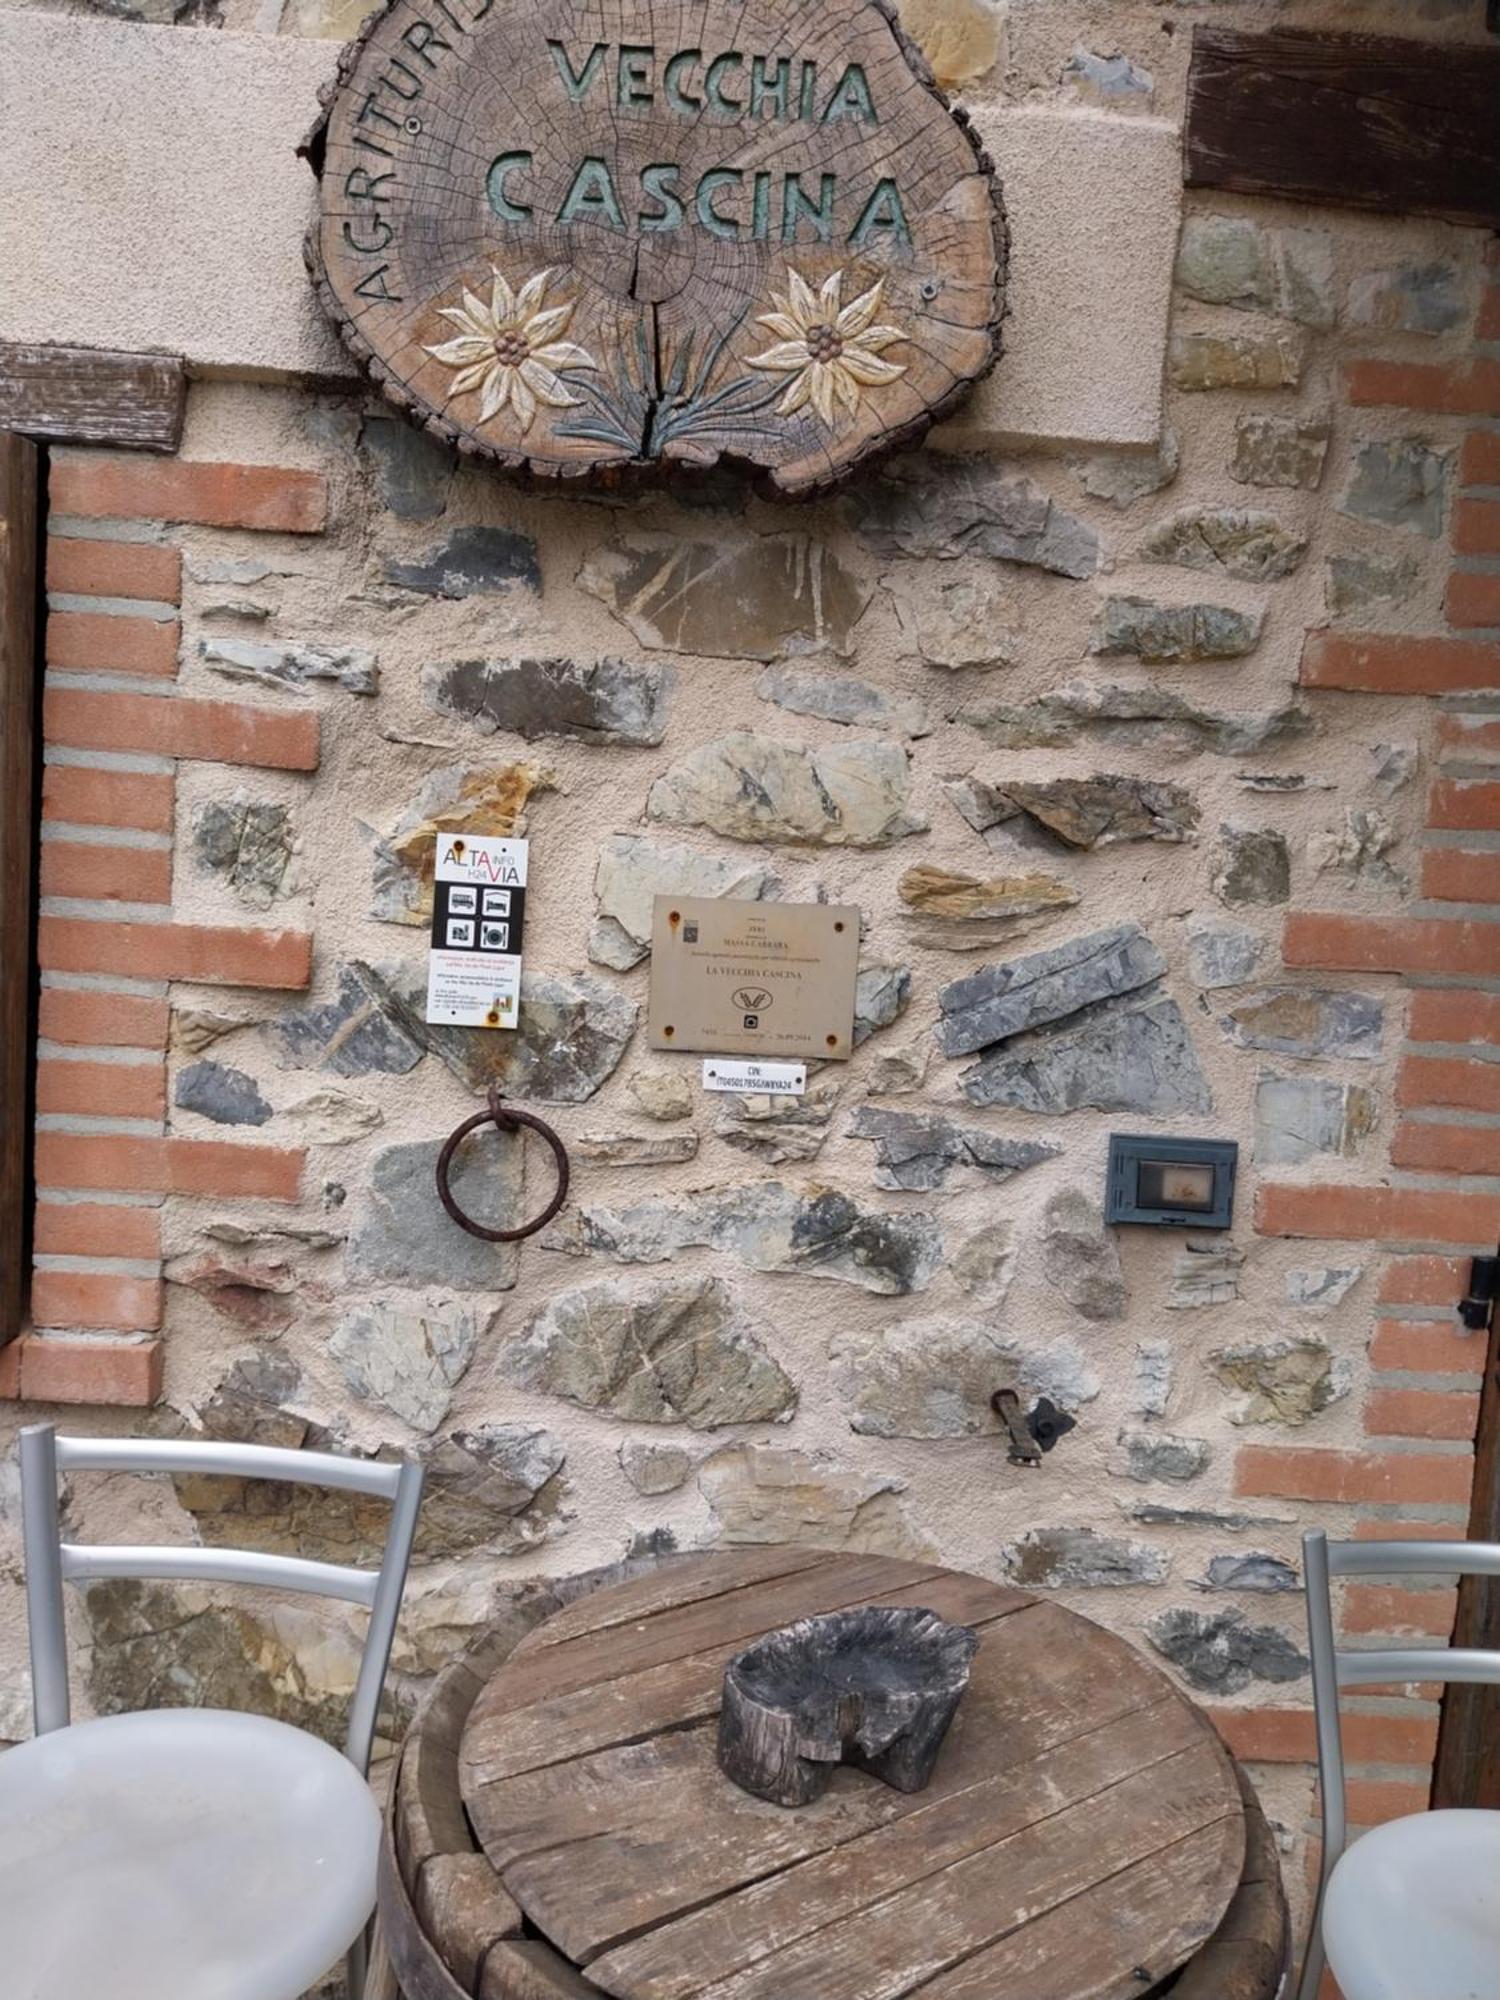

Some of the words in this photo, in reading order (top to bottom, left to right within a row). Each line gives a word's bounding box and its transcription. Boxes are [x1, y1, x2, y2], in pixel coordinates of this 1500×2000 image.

[546, 38, 879, 126] VECCHIA
[485, 148, 914, 247] CASCINA
[467, 869, 488, 879] H24
[493, 855, 515, 866] INFO
